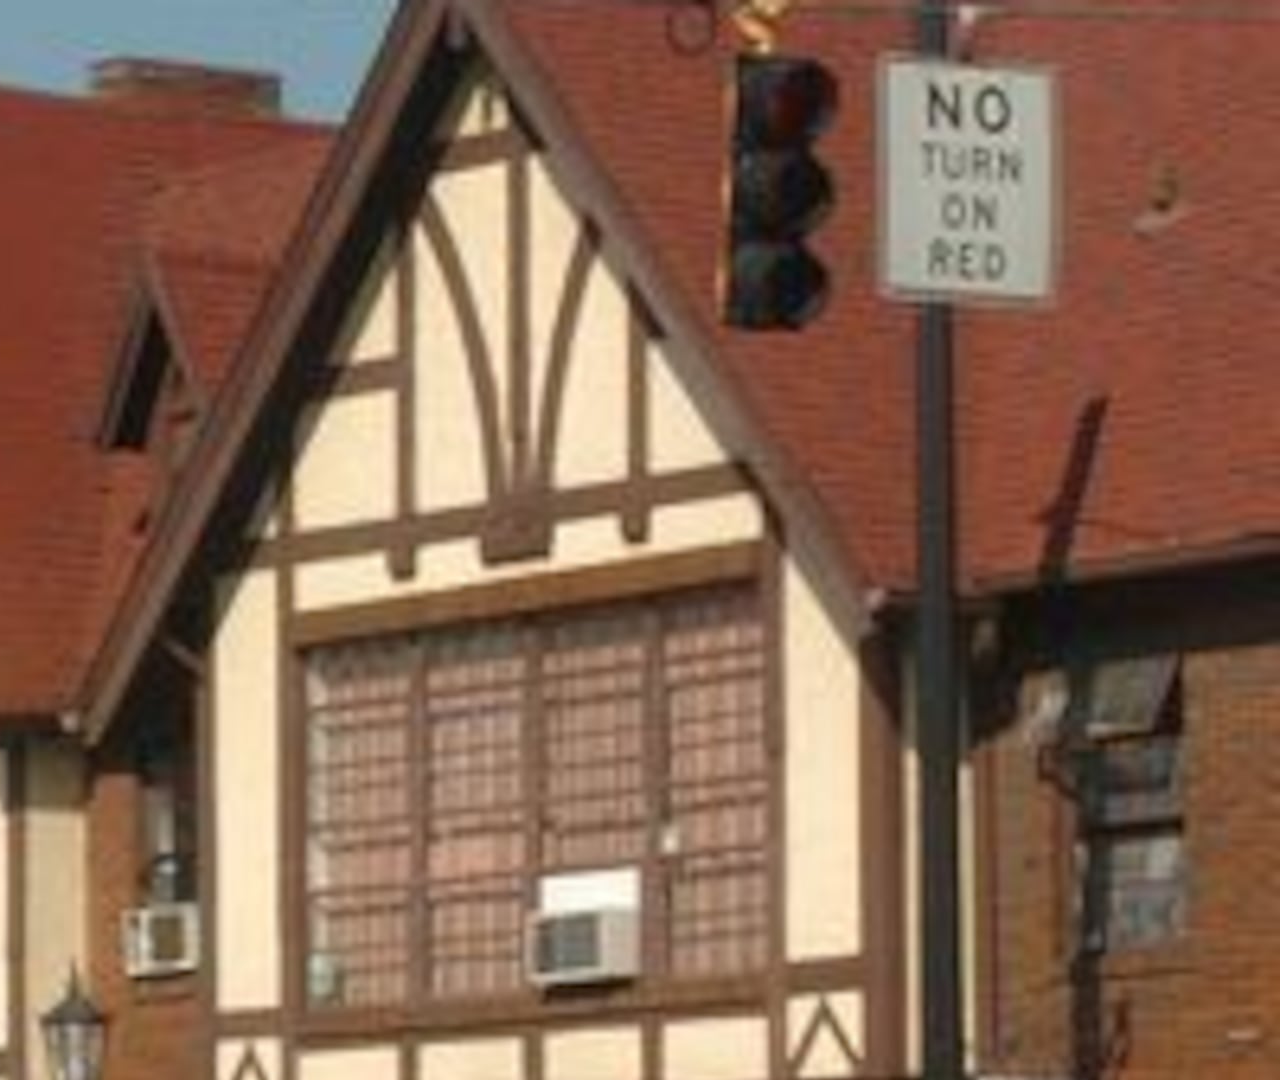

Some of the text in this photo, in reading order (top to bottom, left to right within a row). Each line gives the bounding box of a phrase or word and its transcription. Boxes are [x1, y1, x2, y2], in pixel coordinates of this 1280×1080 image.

[927, 82, 1012, 133] NO
[922, 141, 1024, 182] TURN
[941, 193, 997, 231] ON
[927, 238, 1006, 281] RED
